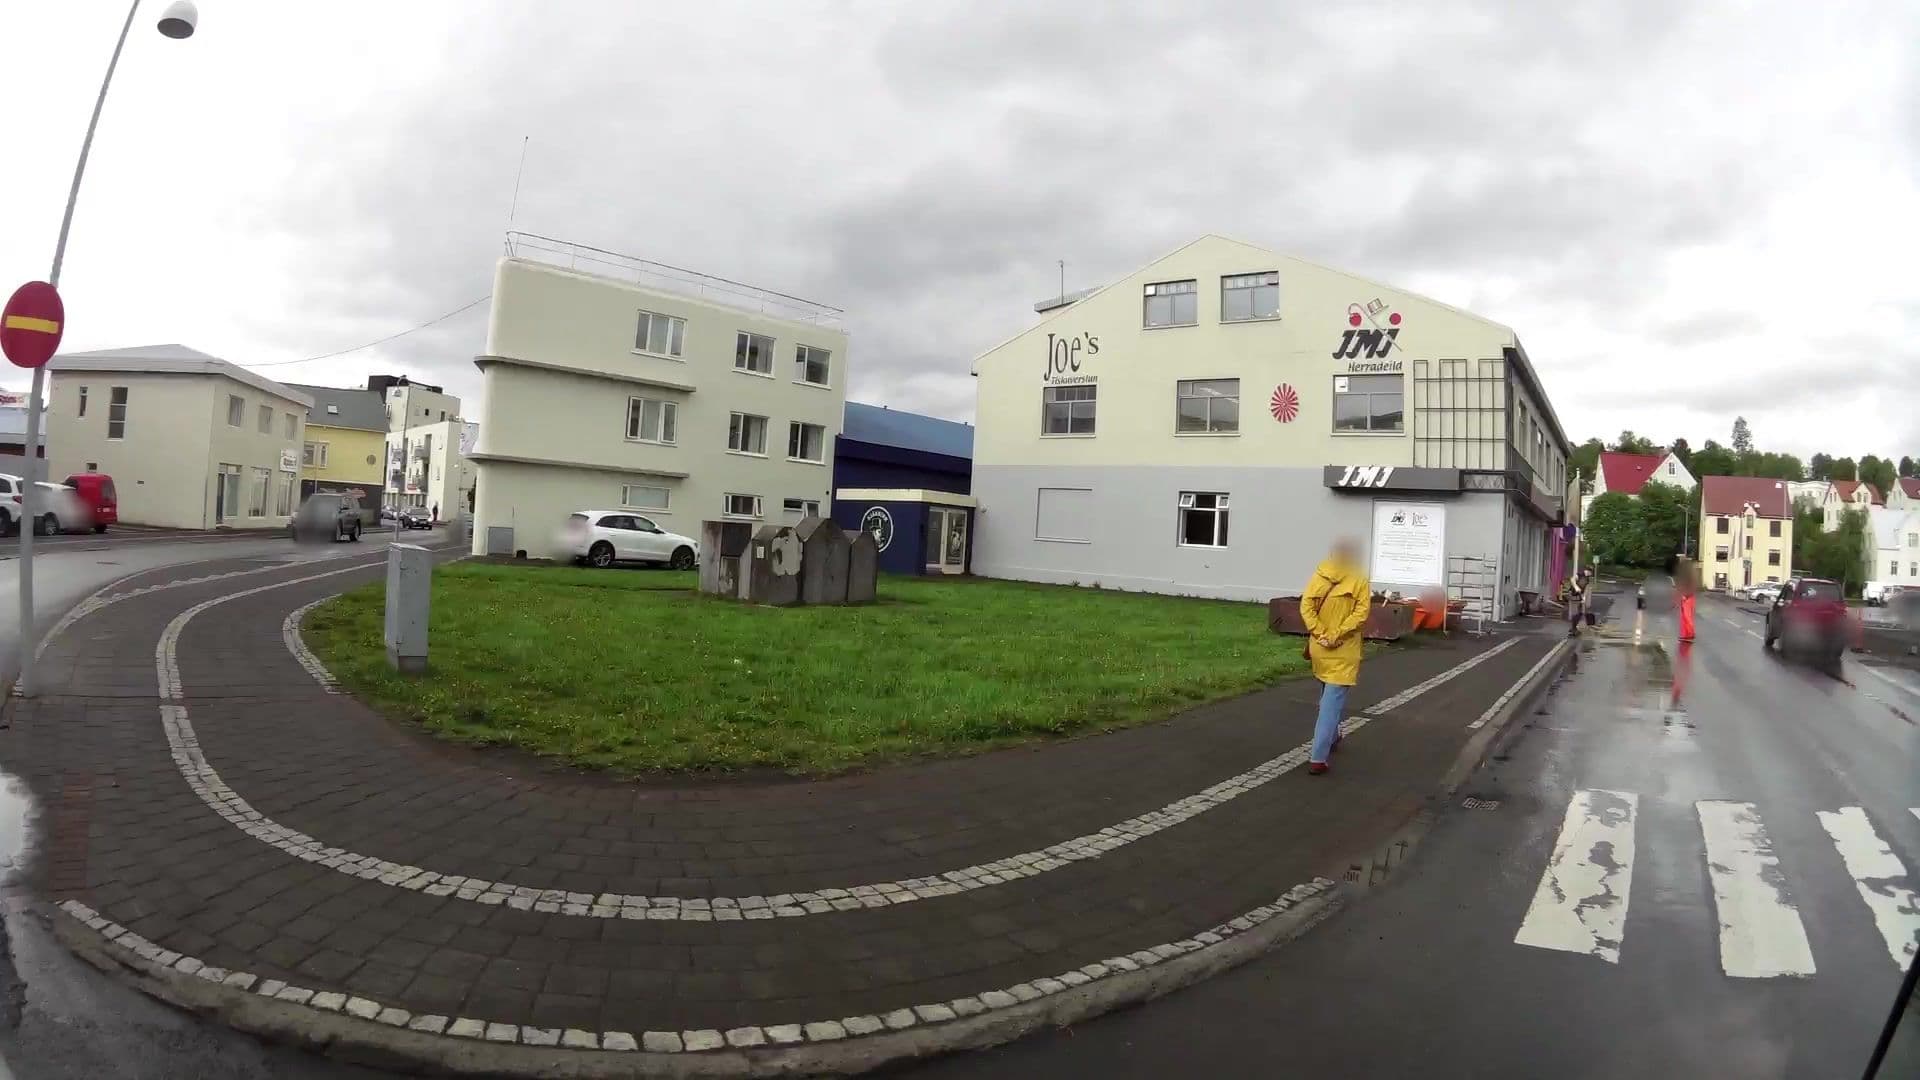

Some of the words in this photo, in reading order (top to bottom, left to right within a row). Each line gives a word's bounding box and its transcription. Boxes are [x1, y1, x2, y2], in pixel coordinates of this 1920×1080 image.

[1044, 331, 1099, 381] Joe's
[1332, 328, 1400, 359] JMJ
[1348, 361, 1403, 372] Herradeild
[1338, 465, 1394, 487] JMJ
